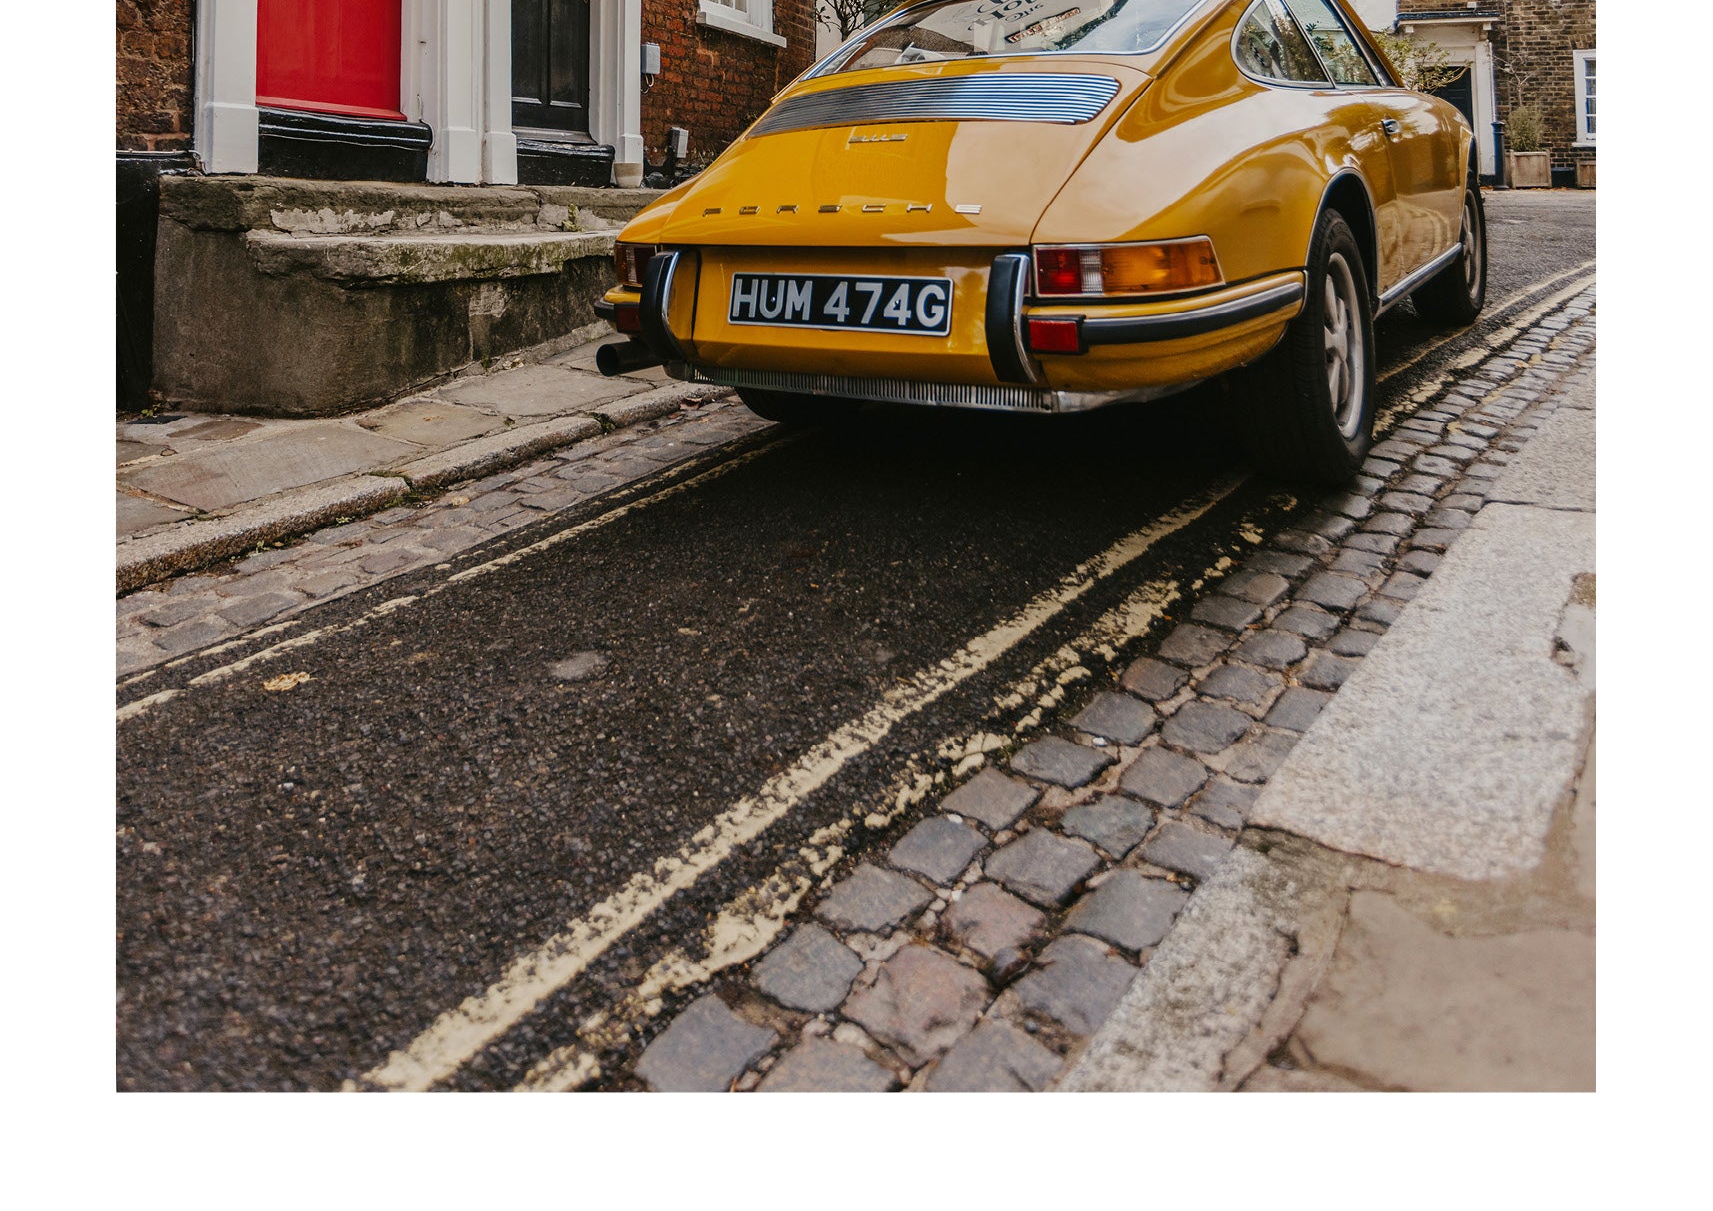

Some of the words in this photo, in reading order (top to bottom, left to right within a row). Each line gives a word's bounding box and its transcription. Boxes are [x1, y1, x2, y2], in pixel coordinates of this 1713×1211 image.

[702, 203, 983, 217] PORSCHE
[732, 277, 814, 322] HUM
[823, 280, 947, 329] 474G
